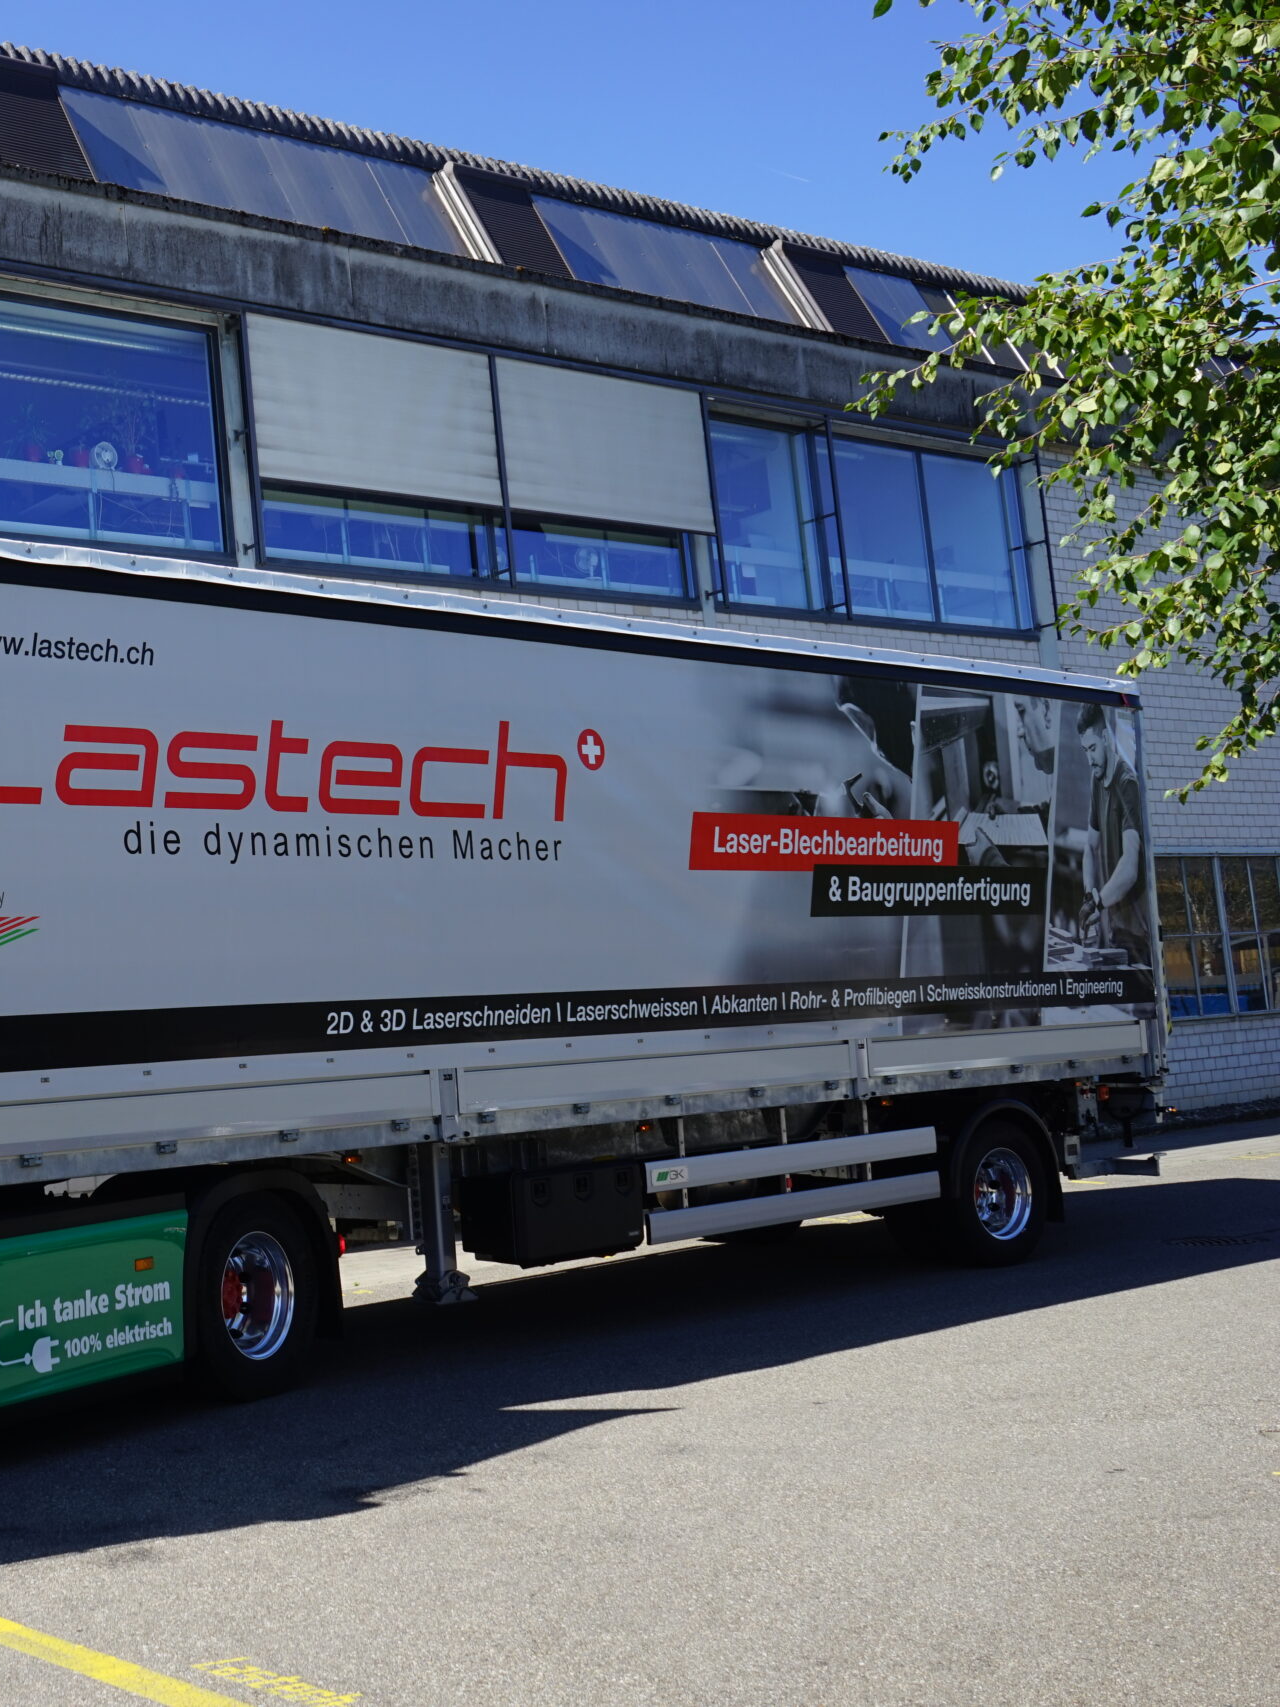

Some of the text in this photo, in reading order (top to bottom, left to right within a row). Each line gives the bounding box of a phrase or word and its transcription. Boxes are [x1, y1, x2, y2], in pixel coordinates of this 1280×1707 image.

[123, 821, 563, 864] die dynamischen Macher
[713, 826, 943, 863] Laser-Blechbearbeitung
[828, 876, 1031, 907] & Baugruppenfertigung
[326, 1010, 354, 1035] 2D
[360, 1009, 374, 1033] &
[379, 1008, 406, 1032] 3D
[412, 1003, 551, 1031] Laserschneiden
[566, 997, 699, 1023] Laserschweissen
[711, 993, 778, 1015] Abkanten
[789, 988, 827, 1011] Rohr-
[831, 988, 841, 1008] &
[844, 985, 917, 1010] Profilbiegen
[926, 981, 1058, 1002] Schweisskonstruktionen
[1065, 976, 1124, 998] Engineering
[18, 1280, 171, 1332] Ich tanke Strom
[64, 1316, 173, 1359] 100% elektrisch
